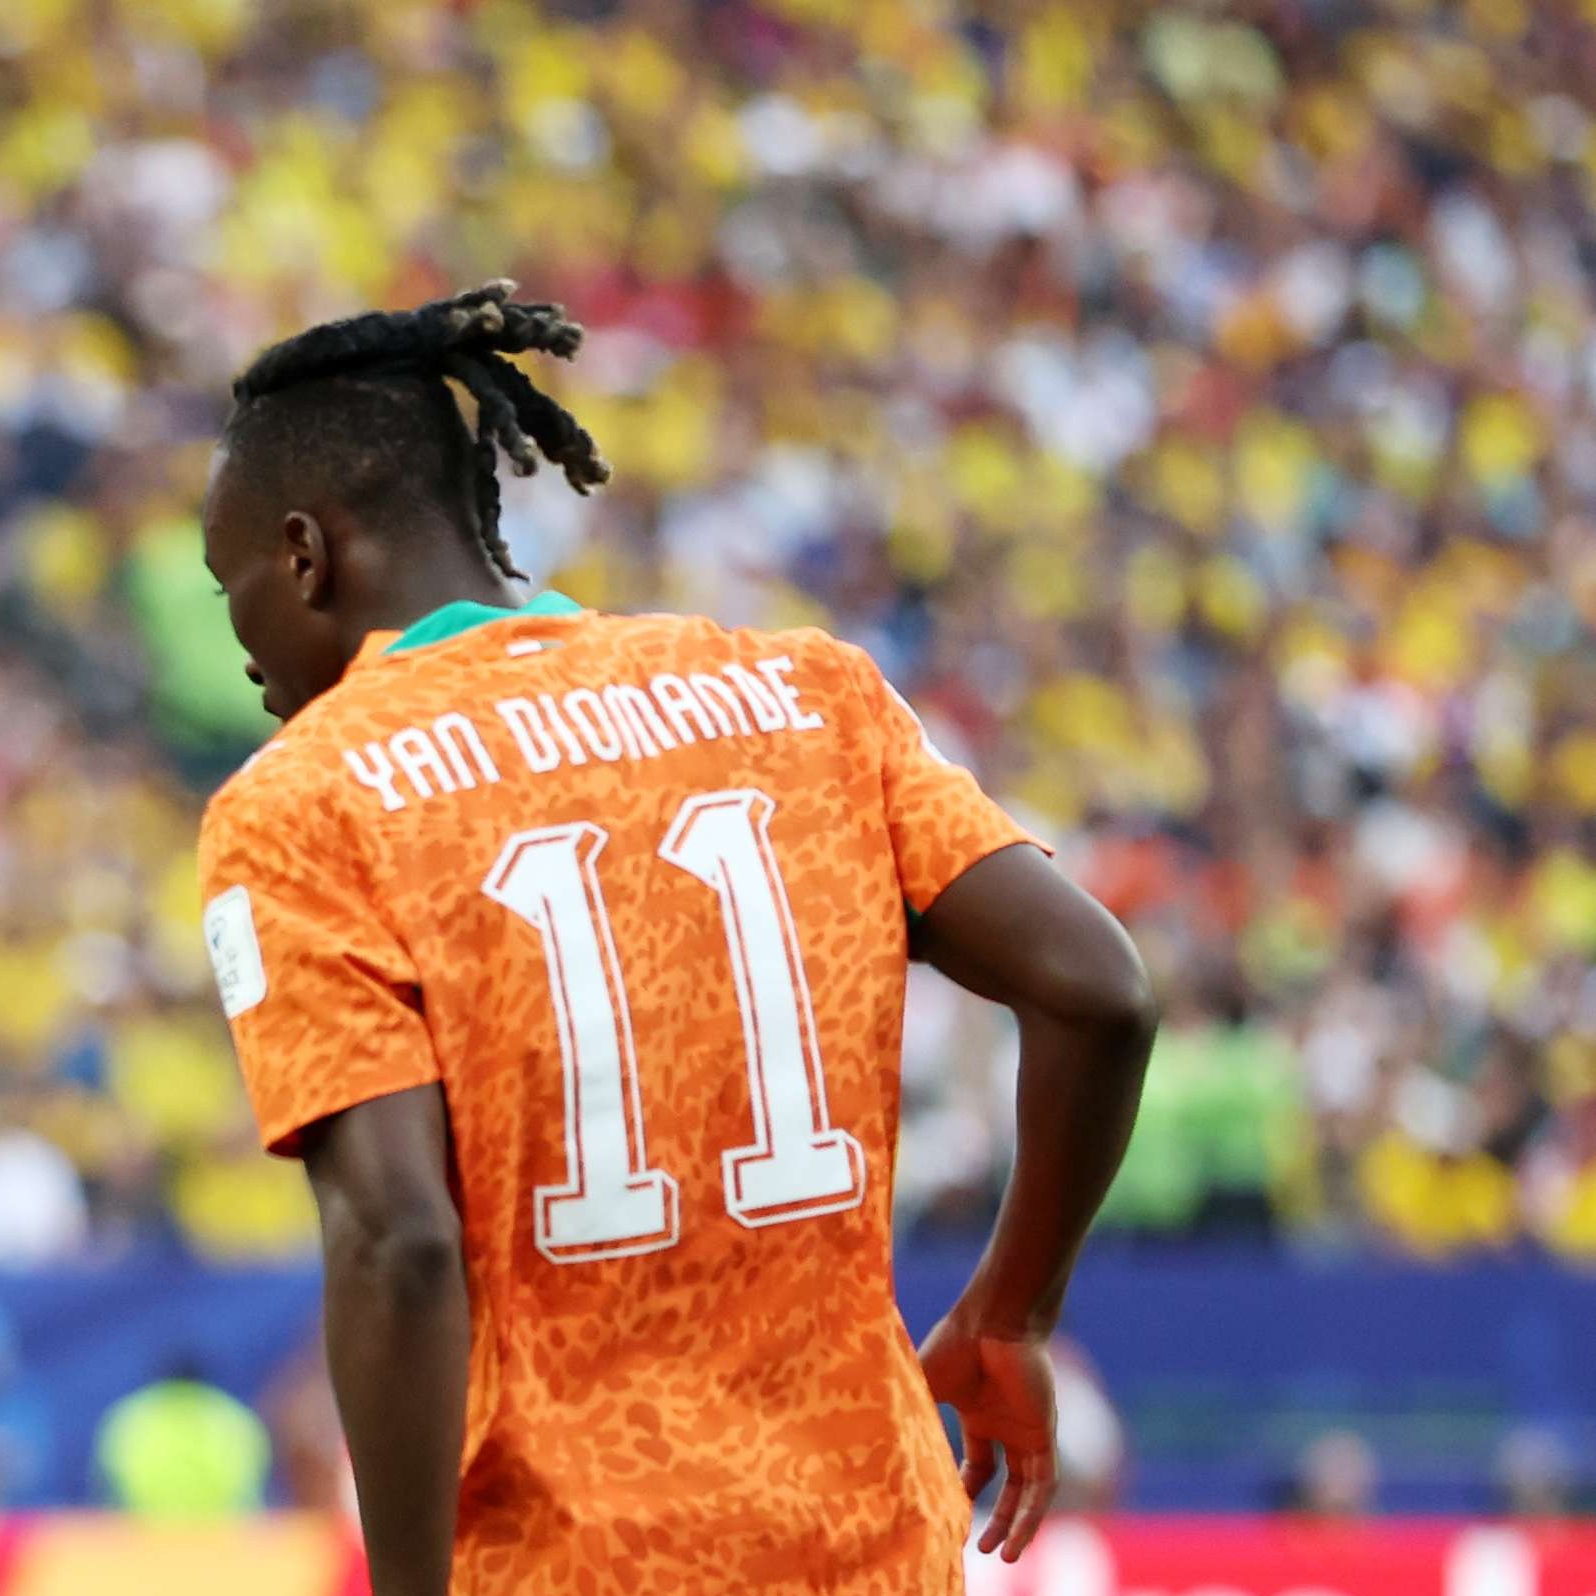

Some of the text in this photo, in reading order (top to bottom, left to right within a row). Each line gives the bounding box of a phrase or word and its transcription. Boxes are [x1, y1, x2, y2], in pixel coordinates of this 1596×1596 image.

[343, 655, 825, 812] YAN DIOMANDE
[481, 788, 867, 1265] 11
